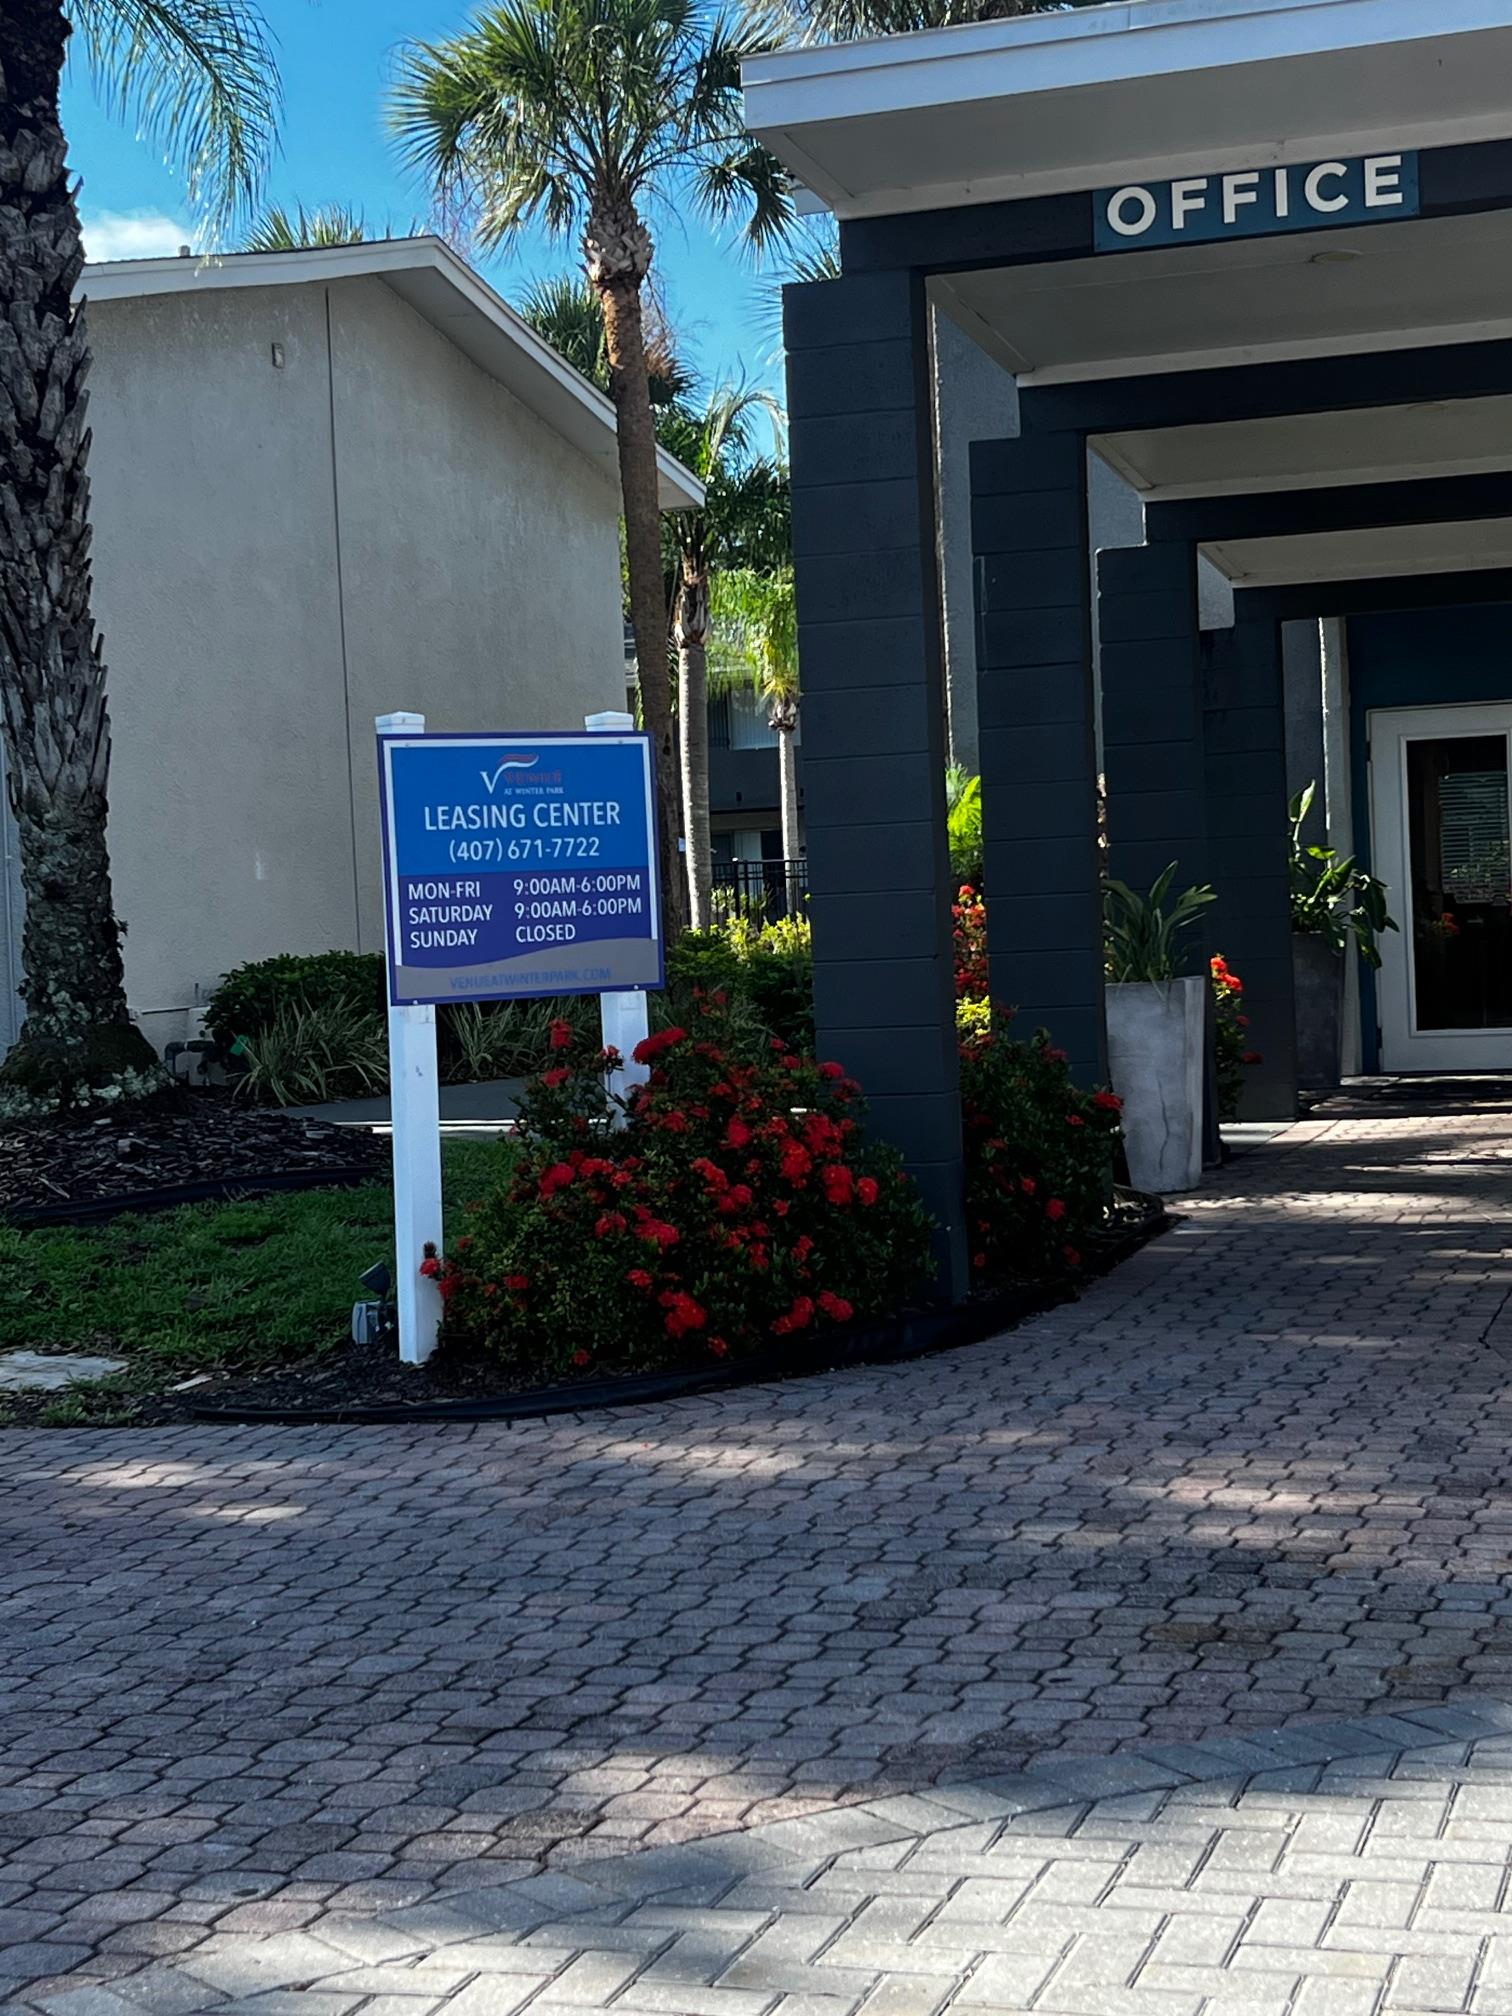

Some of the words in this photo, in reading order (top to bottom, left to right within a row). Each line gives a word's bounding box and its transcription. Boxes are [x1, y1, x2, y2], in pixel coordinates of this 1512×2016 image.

[1107, 155, 1403, 236] OFFICE
[515, 787, 544, 795] WINTER
[546, 786, 564, 794] PARK
[424, 803, 526, 831] LEASING
[533, 801, 621, 827] CENTER
[449, 838, 502, 863] (407)
[507, 837, 600, 858] 671-7722
[408, 881, 481, 901] MON-FRI
[513, 874, 641, 896] 9:00AM-6:00PM
[409, 904, 493, 925] SATURDAY
[514, 897, 642, 920] 9:00AM-6:00PM
[410, 928, 478, 949] SUNDAY
[515, 924, 576, 943] CLOSED
